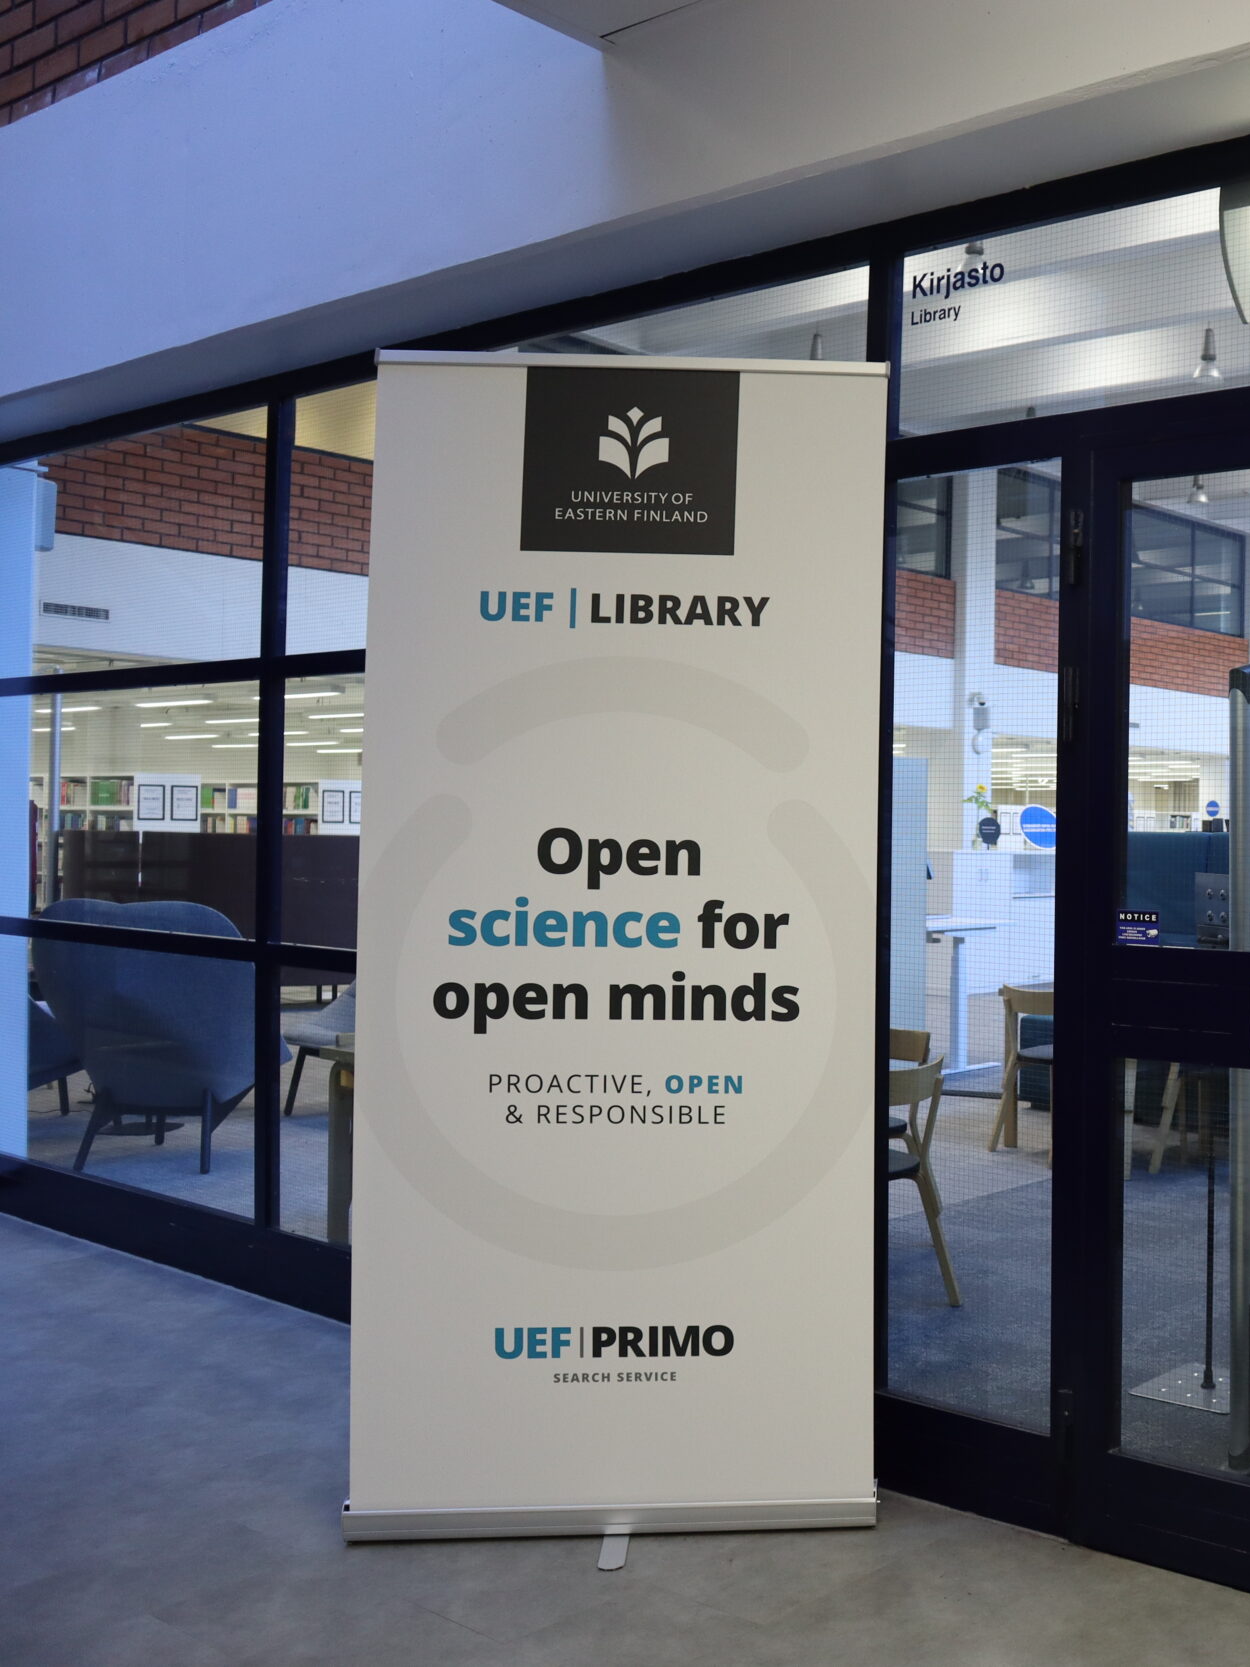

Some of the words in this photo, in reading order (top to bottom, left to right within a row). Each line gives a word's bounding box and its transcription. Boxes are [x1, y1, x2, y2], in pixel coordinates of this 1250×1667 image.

[911, 261, 1005, 299] Kirjasto
[910, 305, 961, 326] Library
[570, 490, 669, 506] UNIVERSITY
[671, 493, 694, 506] OF
[554, 507, 629, 521] EASTERN
[633, 509, 709, 524] FINLAND
[479, 590, 554, 624] UEF
[590, 593, 771, 628] LIBRARY
[537, 827, 701, 890] Open
[448, 896, 681, 949] science
[697, 899, 790, 950] for
[1119, 913, 1157, 921] NOTICE
[432, 981, 589, 1035] open
[608, 970, 800, 1022] minds
[488, 1073, 651, 1097] PROACTIVE,
[665, 1074, 744, 1095] OPEN
[505, 1104, 523, 1124] &
[537, 1104, 726, 1124] RESPONSIBLE
[494, 1327, 572, 1360] UEF
[592, 1324, 735, 1358] PRIMO
[553, 1372, 611, 1384] SEARCH
[616, 1371, 677, 1383] SERVICE
